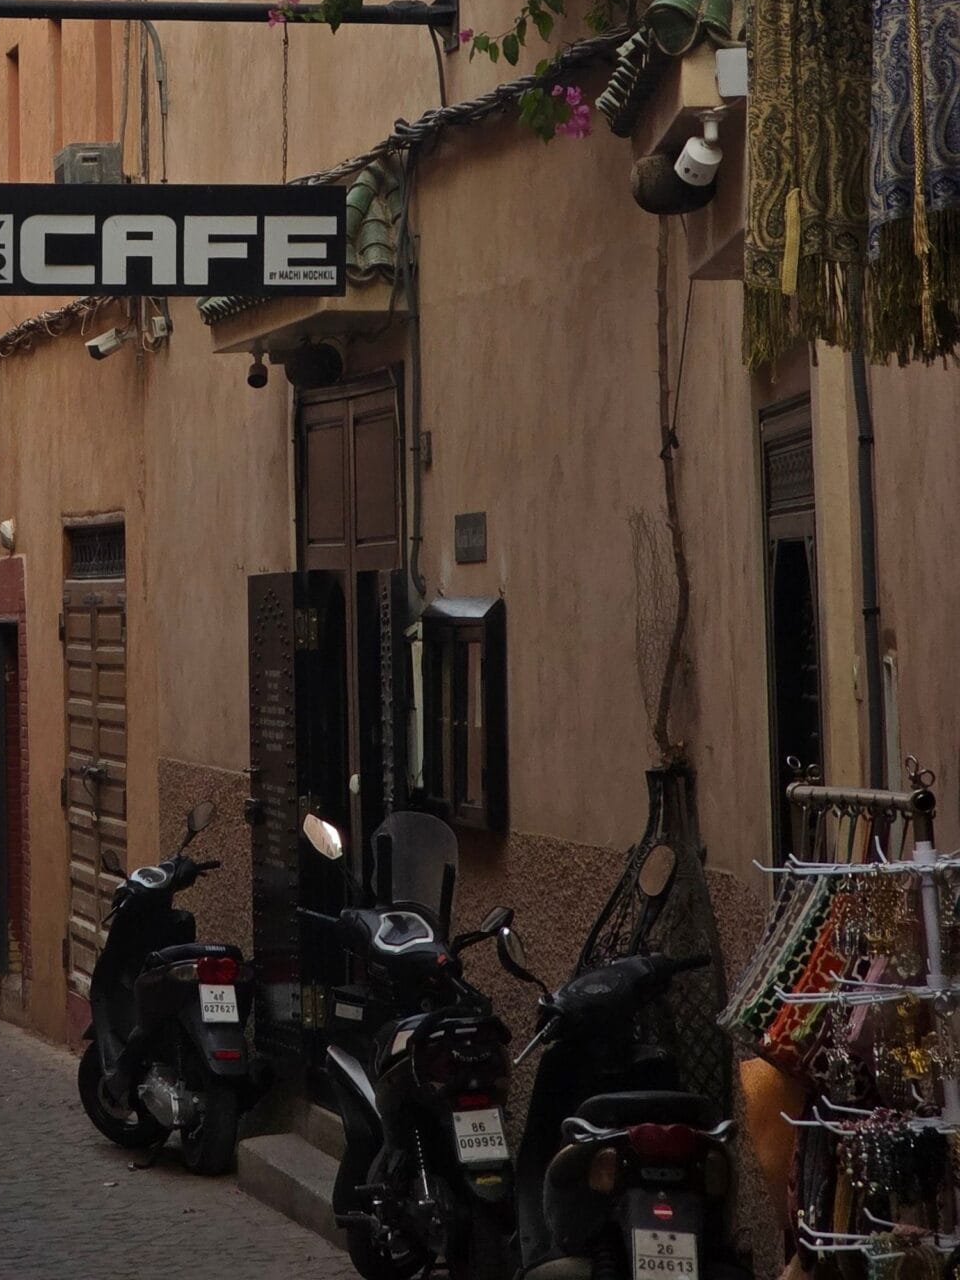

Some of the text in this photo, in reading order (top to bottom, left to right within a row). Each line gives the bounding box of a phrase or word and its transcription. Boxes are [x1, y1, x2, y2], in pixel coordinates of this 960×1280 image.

[20, 215, 337, 285] CAFE
[269, 270, 335, 280] BY MACHI MOCHKIL
[204, 1004, 235, 1013] 027627
[471, 1122, 486, 1133] 86
[460, 1135, 504, 1149] 009952
[657, 1243, 674, 1255] 26
[639, 1258, 694, 1272] 204613
